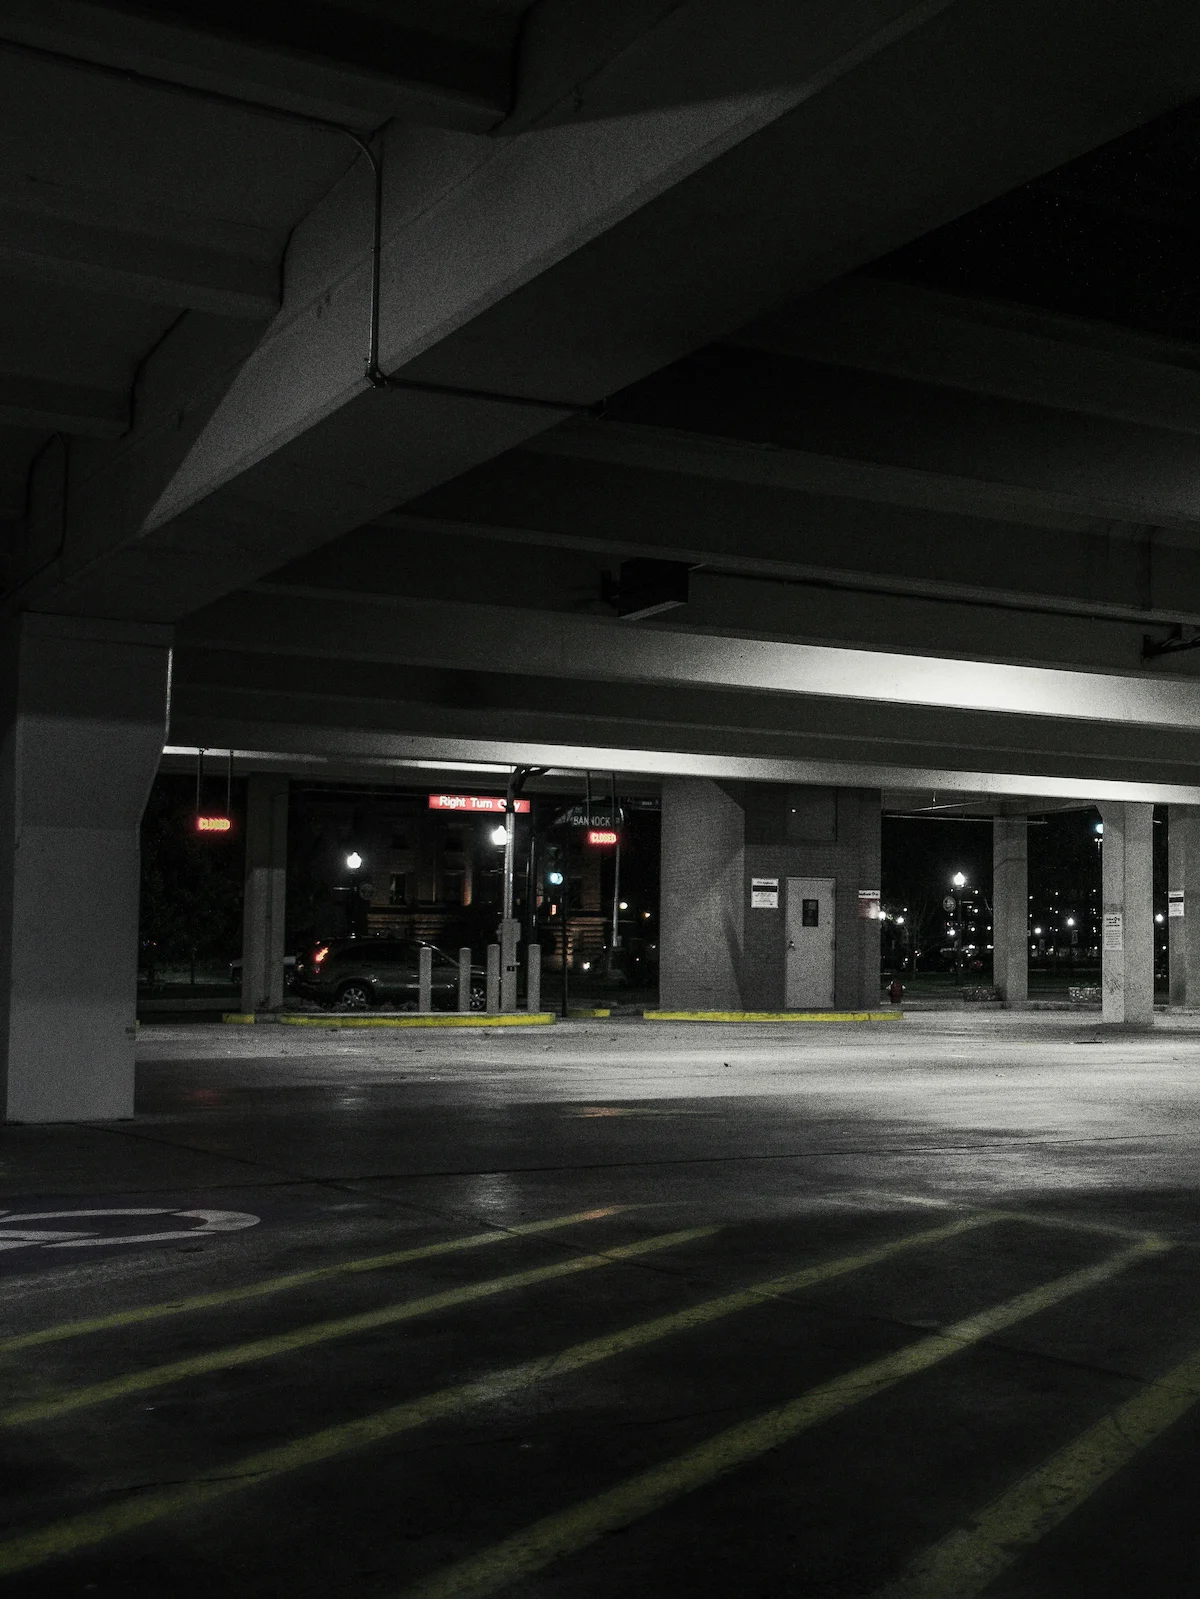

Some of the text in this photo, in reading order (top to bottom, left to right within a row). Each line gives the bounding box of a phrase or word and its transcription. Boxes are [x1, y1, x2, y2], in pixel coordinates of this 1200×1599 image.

[439, 796, 520, 811] Right Turn Oy
[199, 817, 231, 830] CLOSED
[590, 833, 617, 845] CLOSED
